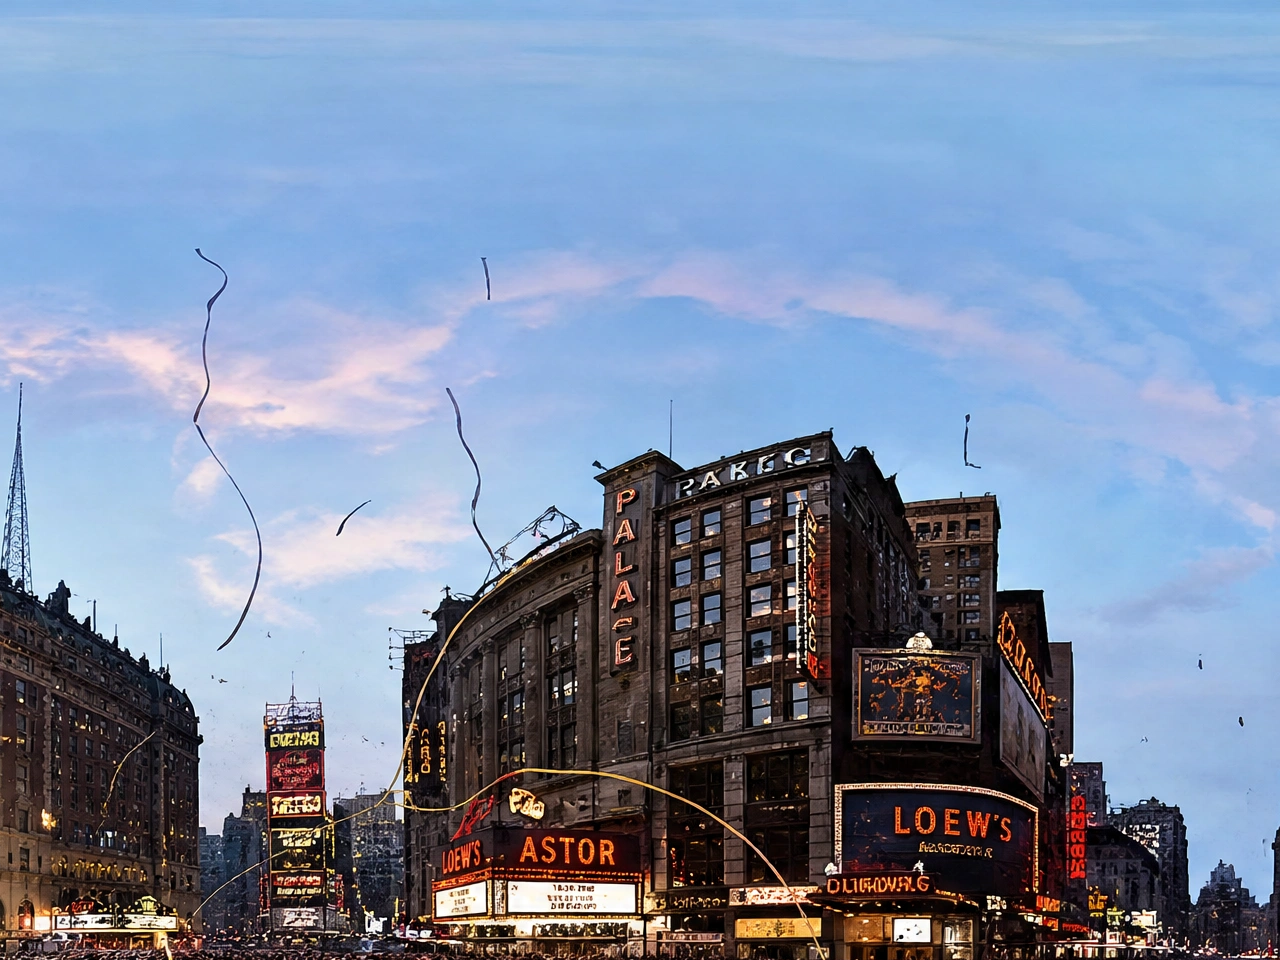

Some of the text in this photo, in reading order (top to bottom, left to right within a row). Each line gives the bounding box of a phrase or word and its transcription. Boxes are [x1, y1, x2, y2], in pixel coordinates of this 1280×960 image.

[893, 806, 1013, 842] LOEW'S
[441, 839, 481, 875] LOEW'S
[519, 836, 616, 866] ASTOR
